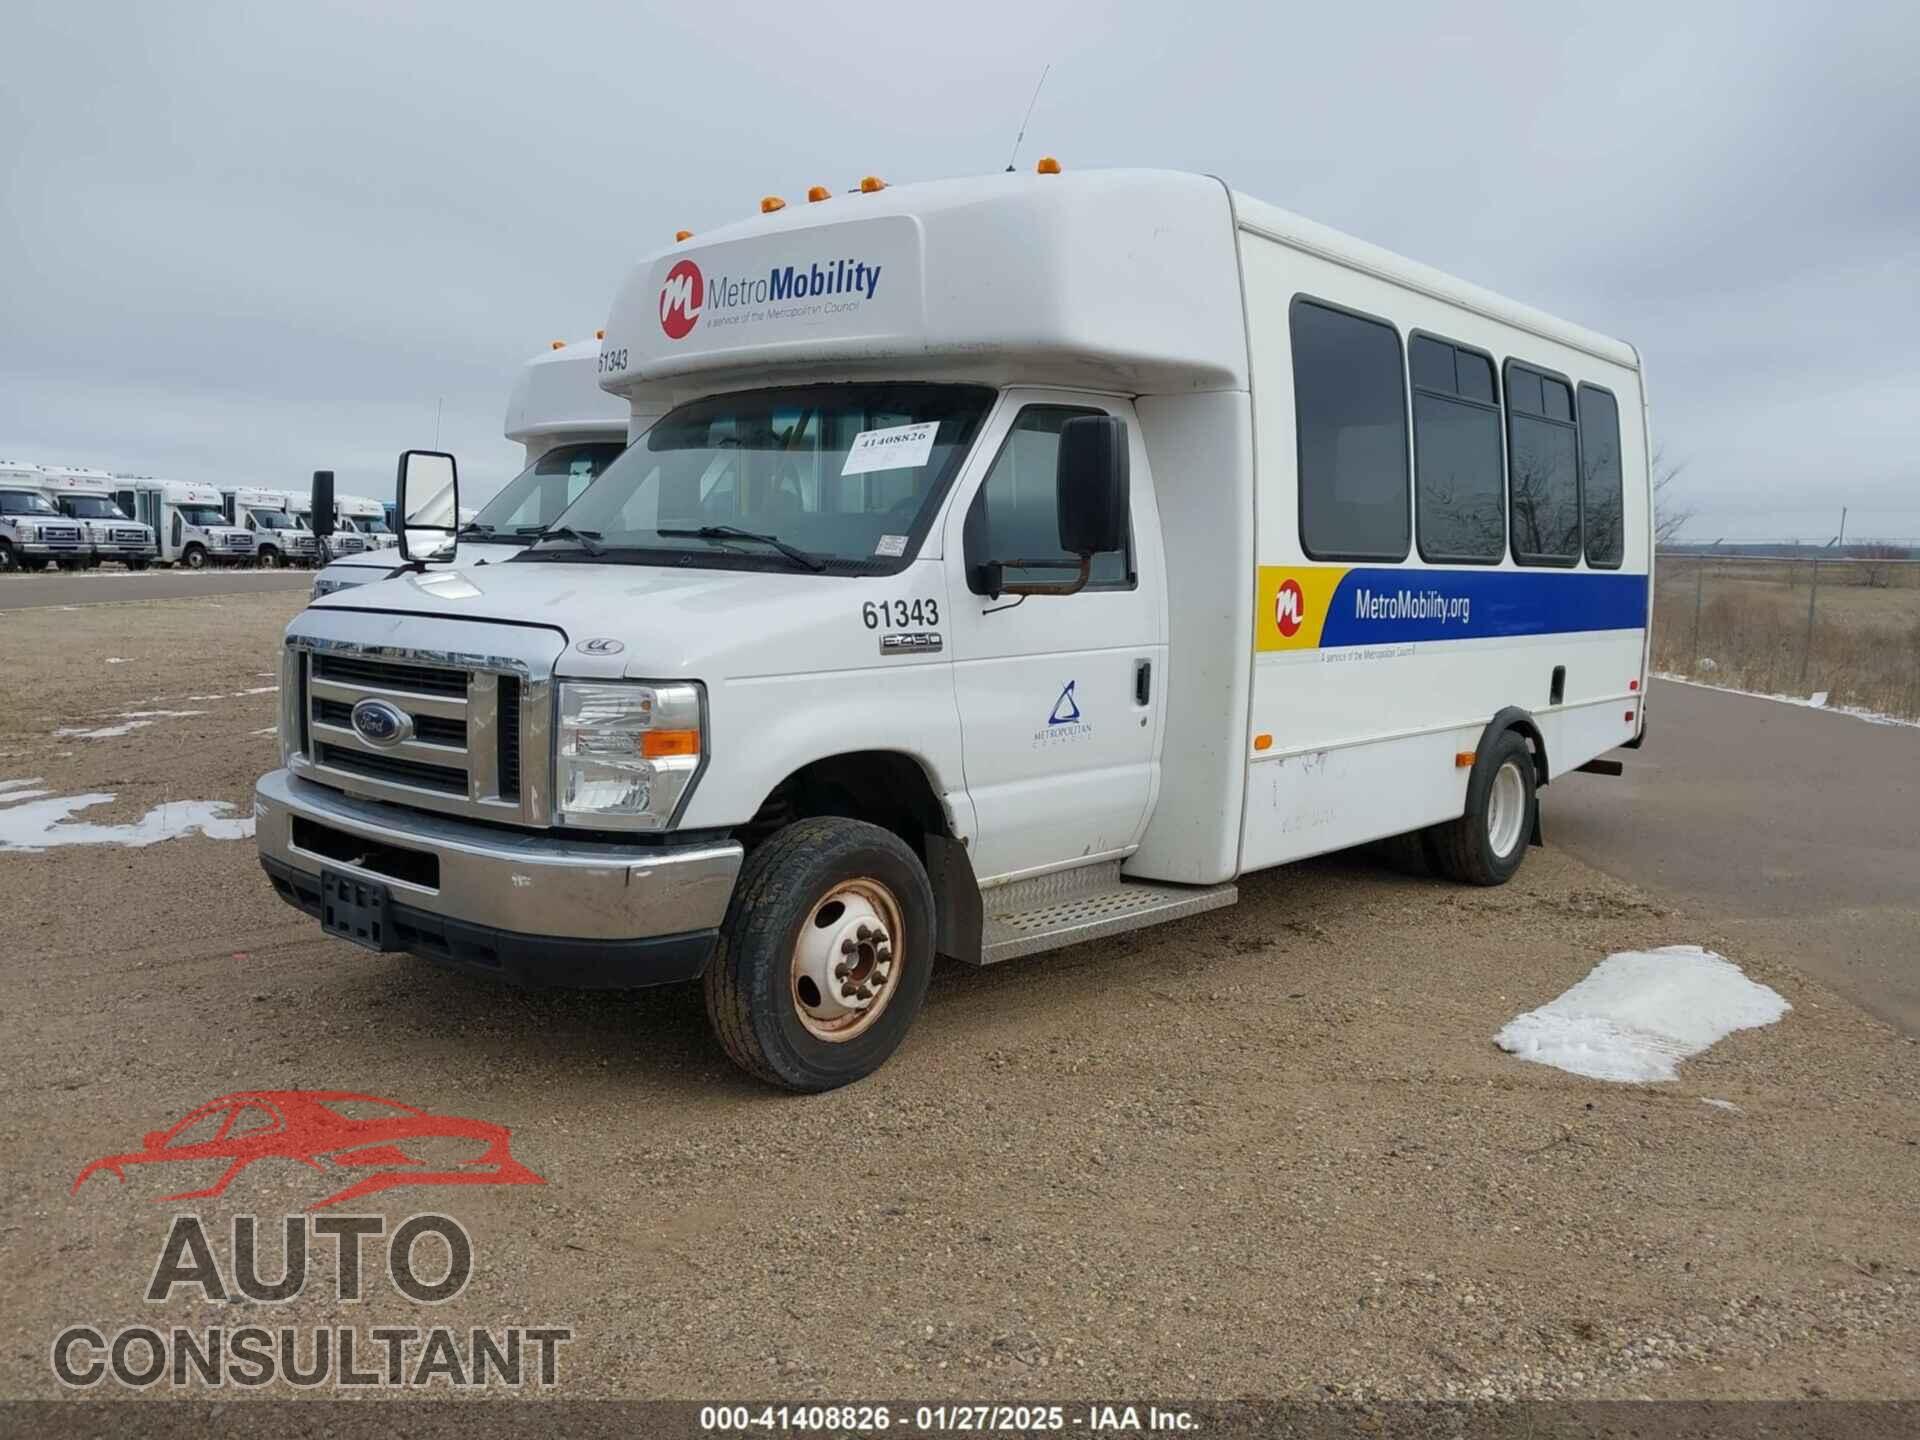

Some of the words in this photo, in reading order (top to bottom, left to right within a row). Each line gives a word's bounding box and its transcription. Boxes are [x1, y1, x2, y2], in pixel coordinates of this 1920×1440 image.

[707, 258, 882, 311] MetroMobility
[824, 300, 860, 314] Council
[862, 431, 927, 448] 41408826
[862, 598, 939, 630] 61343
[1355, 588, 1470, 625] MetroMobility.org
[360, 711, 384, 732] Ford
[1032, 724, 1092, 740] METROPOLITAN
